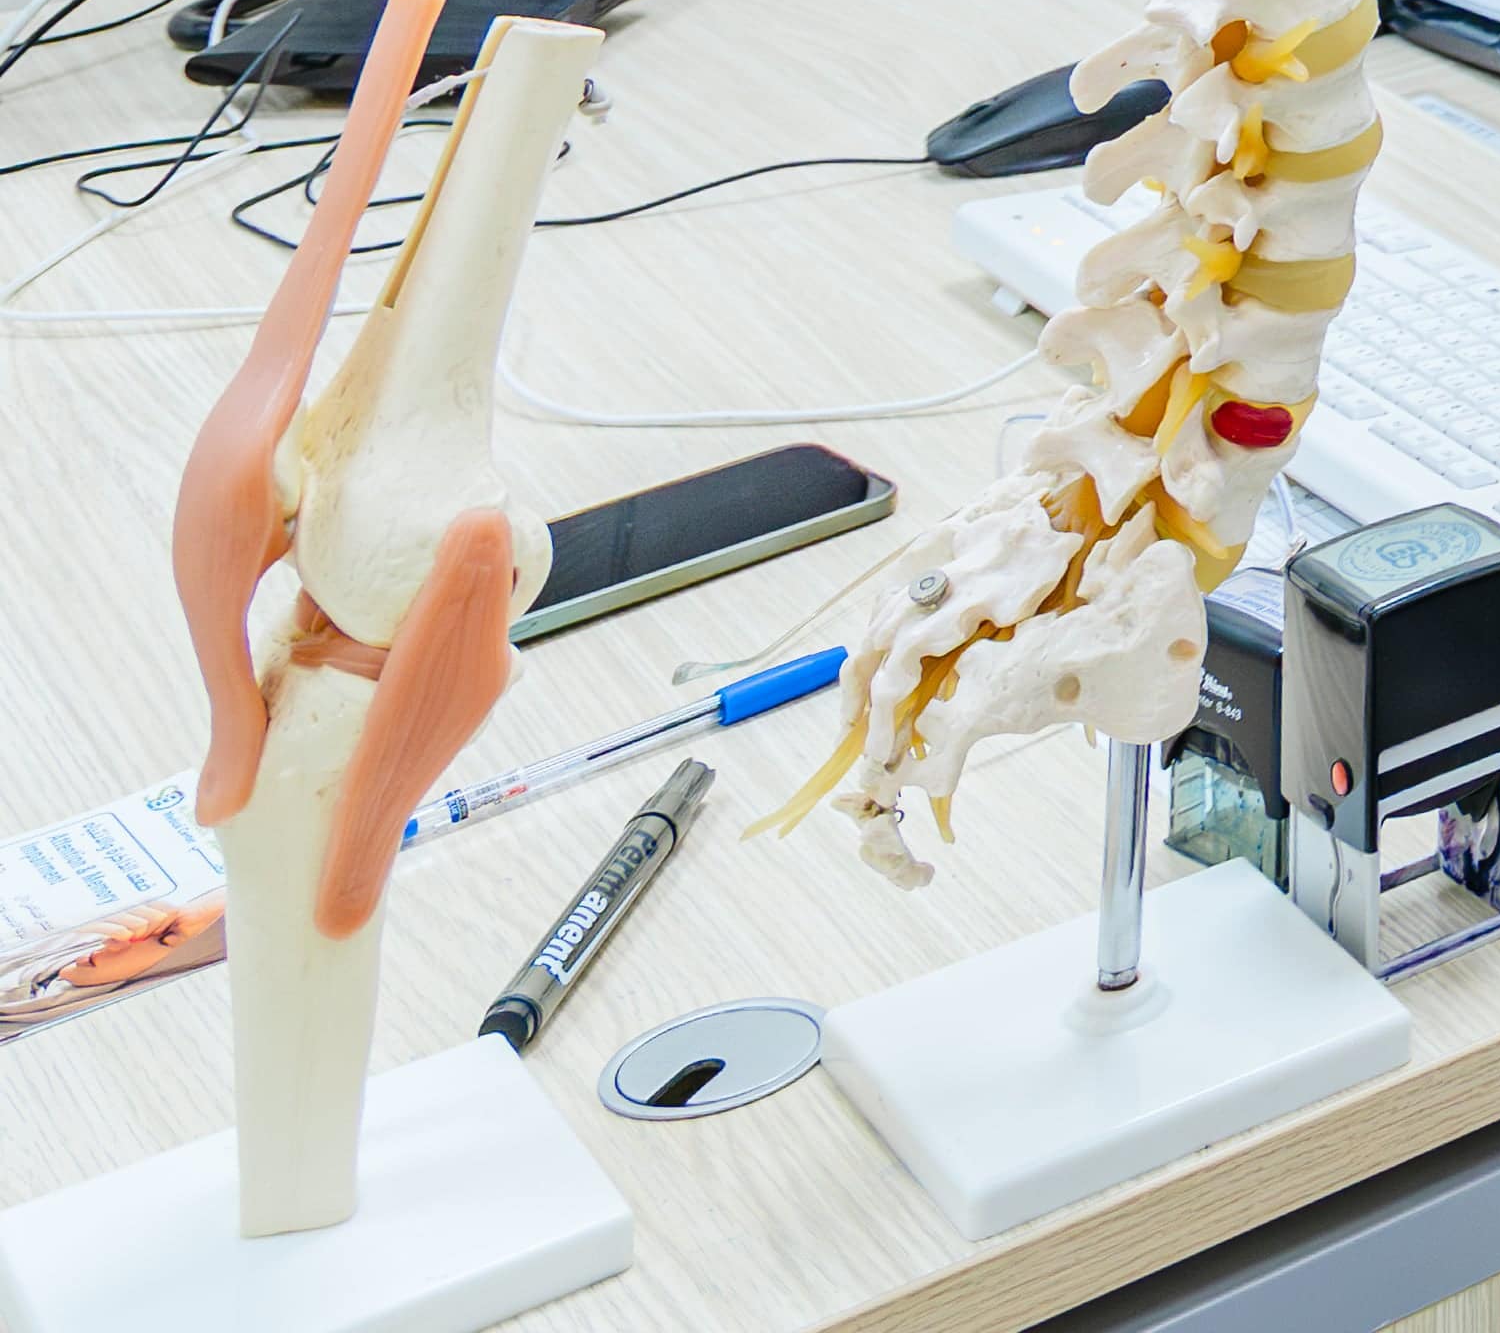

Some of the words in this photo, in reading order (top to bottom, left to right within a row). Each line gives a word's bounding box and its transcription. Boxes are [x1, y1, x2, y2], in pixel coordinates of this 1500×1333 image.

[20, 841, 69, 885] Impairment
[48, 832, 87, 870] Attention
[83, 870, 120, 905] Memory
[533, 828, 658, 981] Permanent
